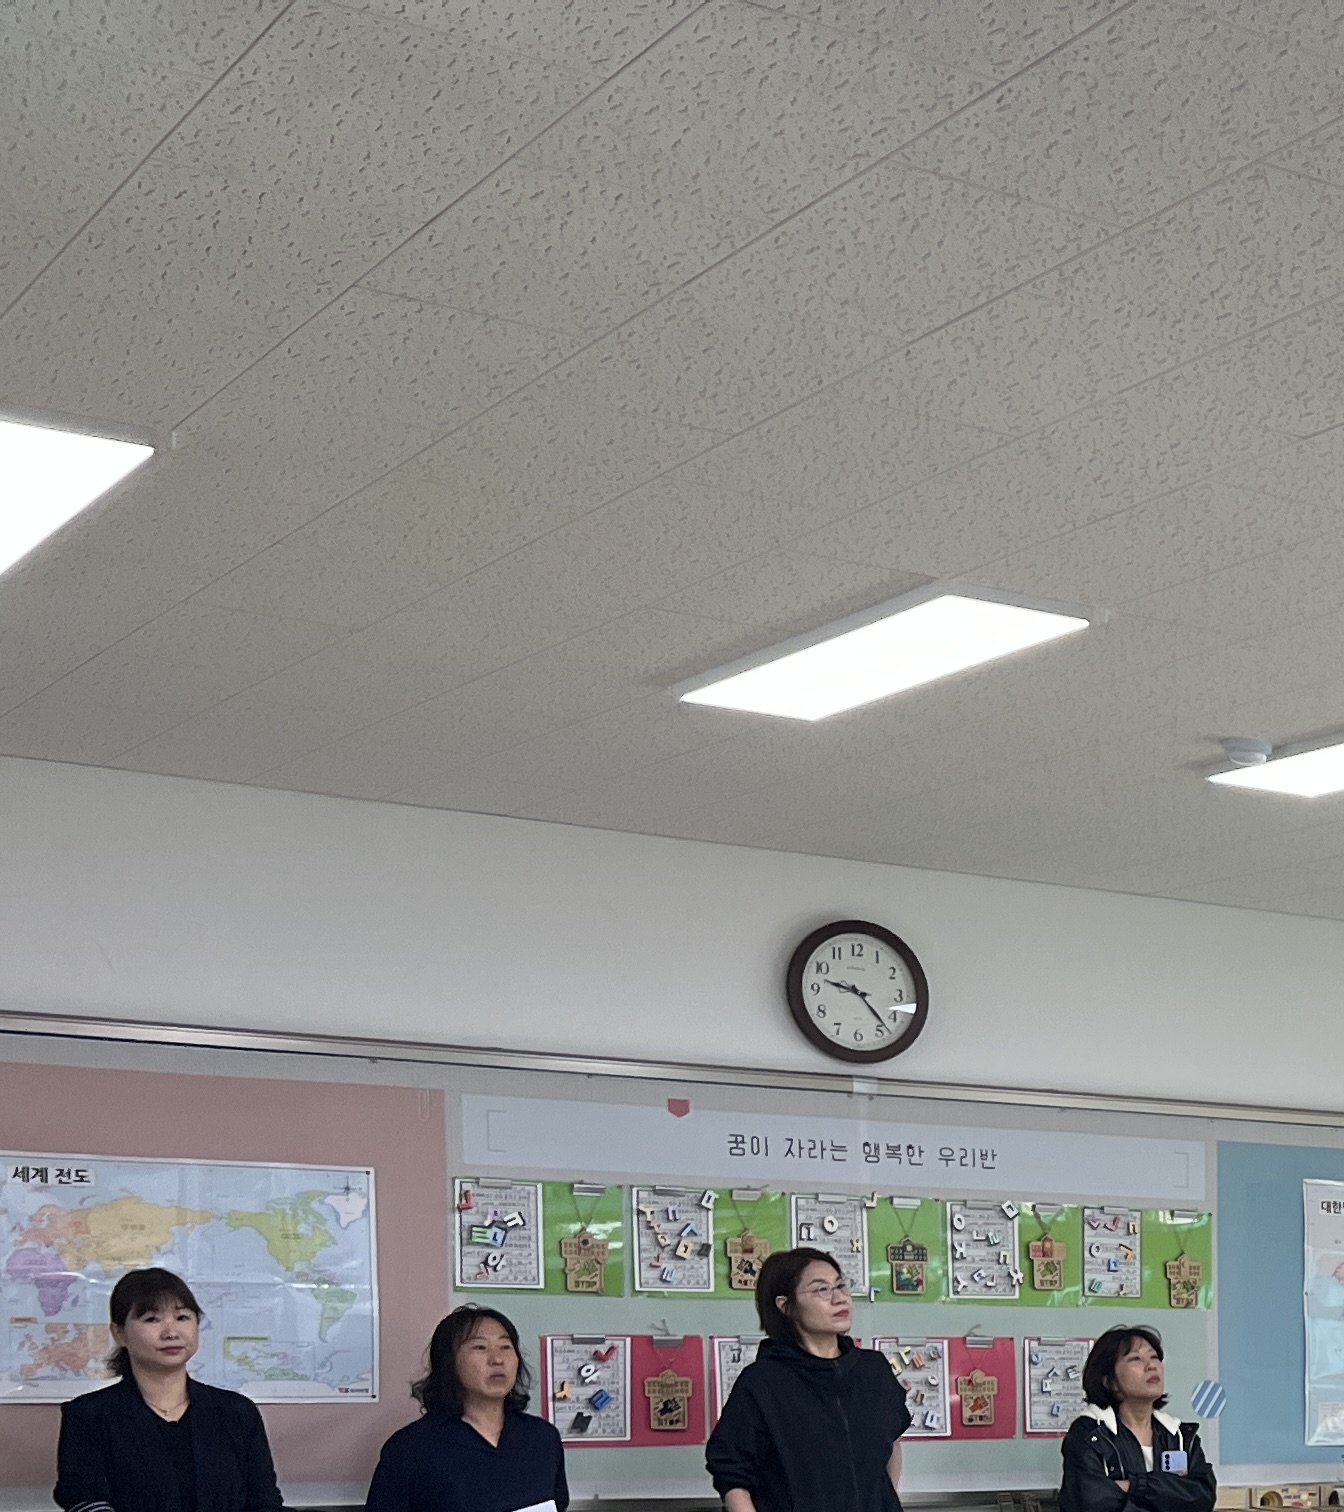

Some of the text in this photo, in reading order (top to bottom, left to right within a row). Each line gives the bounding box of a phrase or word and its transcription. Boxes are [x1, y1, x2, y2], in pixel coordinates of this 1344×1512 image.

[832, 946, 842, 960] 11
[851, 943, 864, 957] 12
[875, 950, 880, 964] 1
[815, 961, 829, 975] 10
[888, 966, 897, 980] 2
[810, 982, 821, 995] 9
[893, 989, 903, 1003] 3
[817, 1004, 827, 1018] 8
[888, 1010, 897, 1023] 4
[833, 1022, 842, 1036] 7
[853, 1029, 864, 1042] 6
[875, 1024, 885, 1038] 5
[727, 1133, 998, 1170] 꿈이 자라는 행복한 우리반
[12, 1166, 91, 1185] 세계 전도
